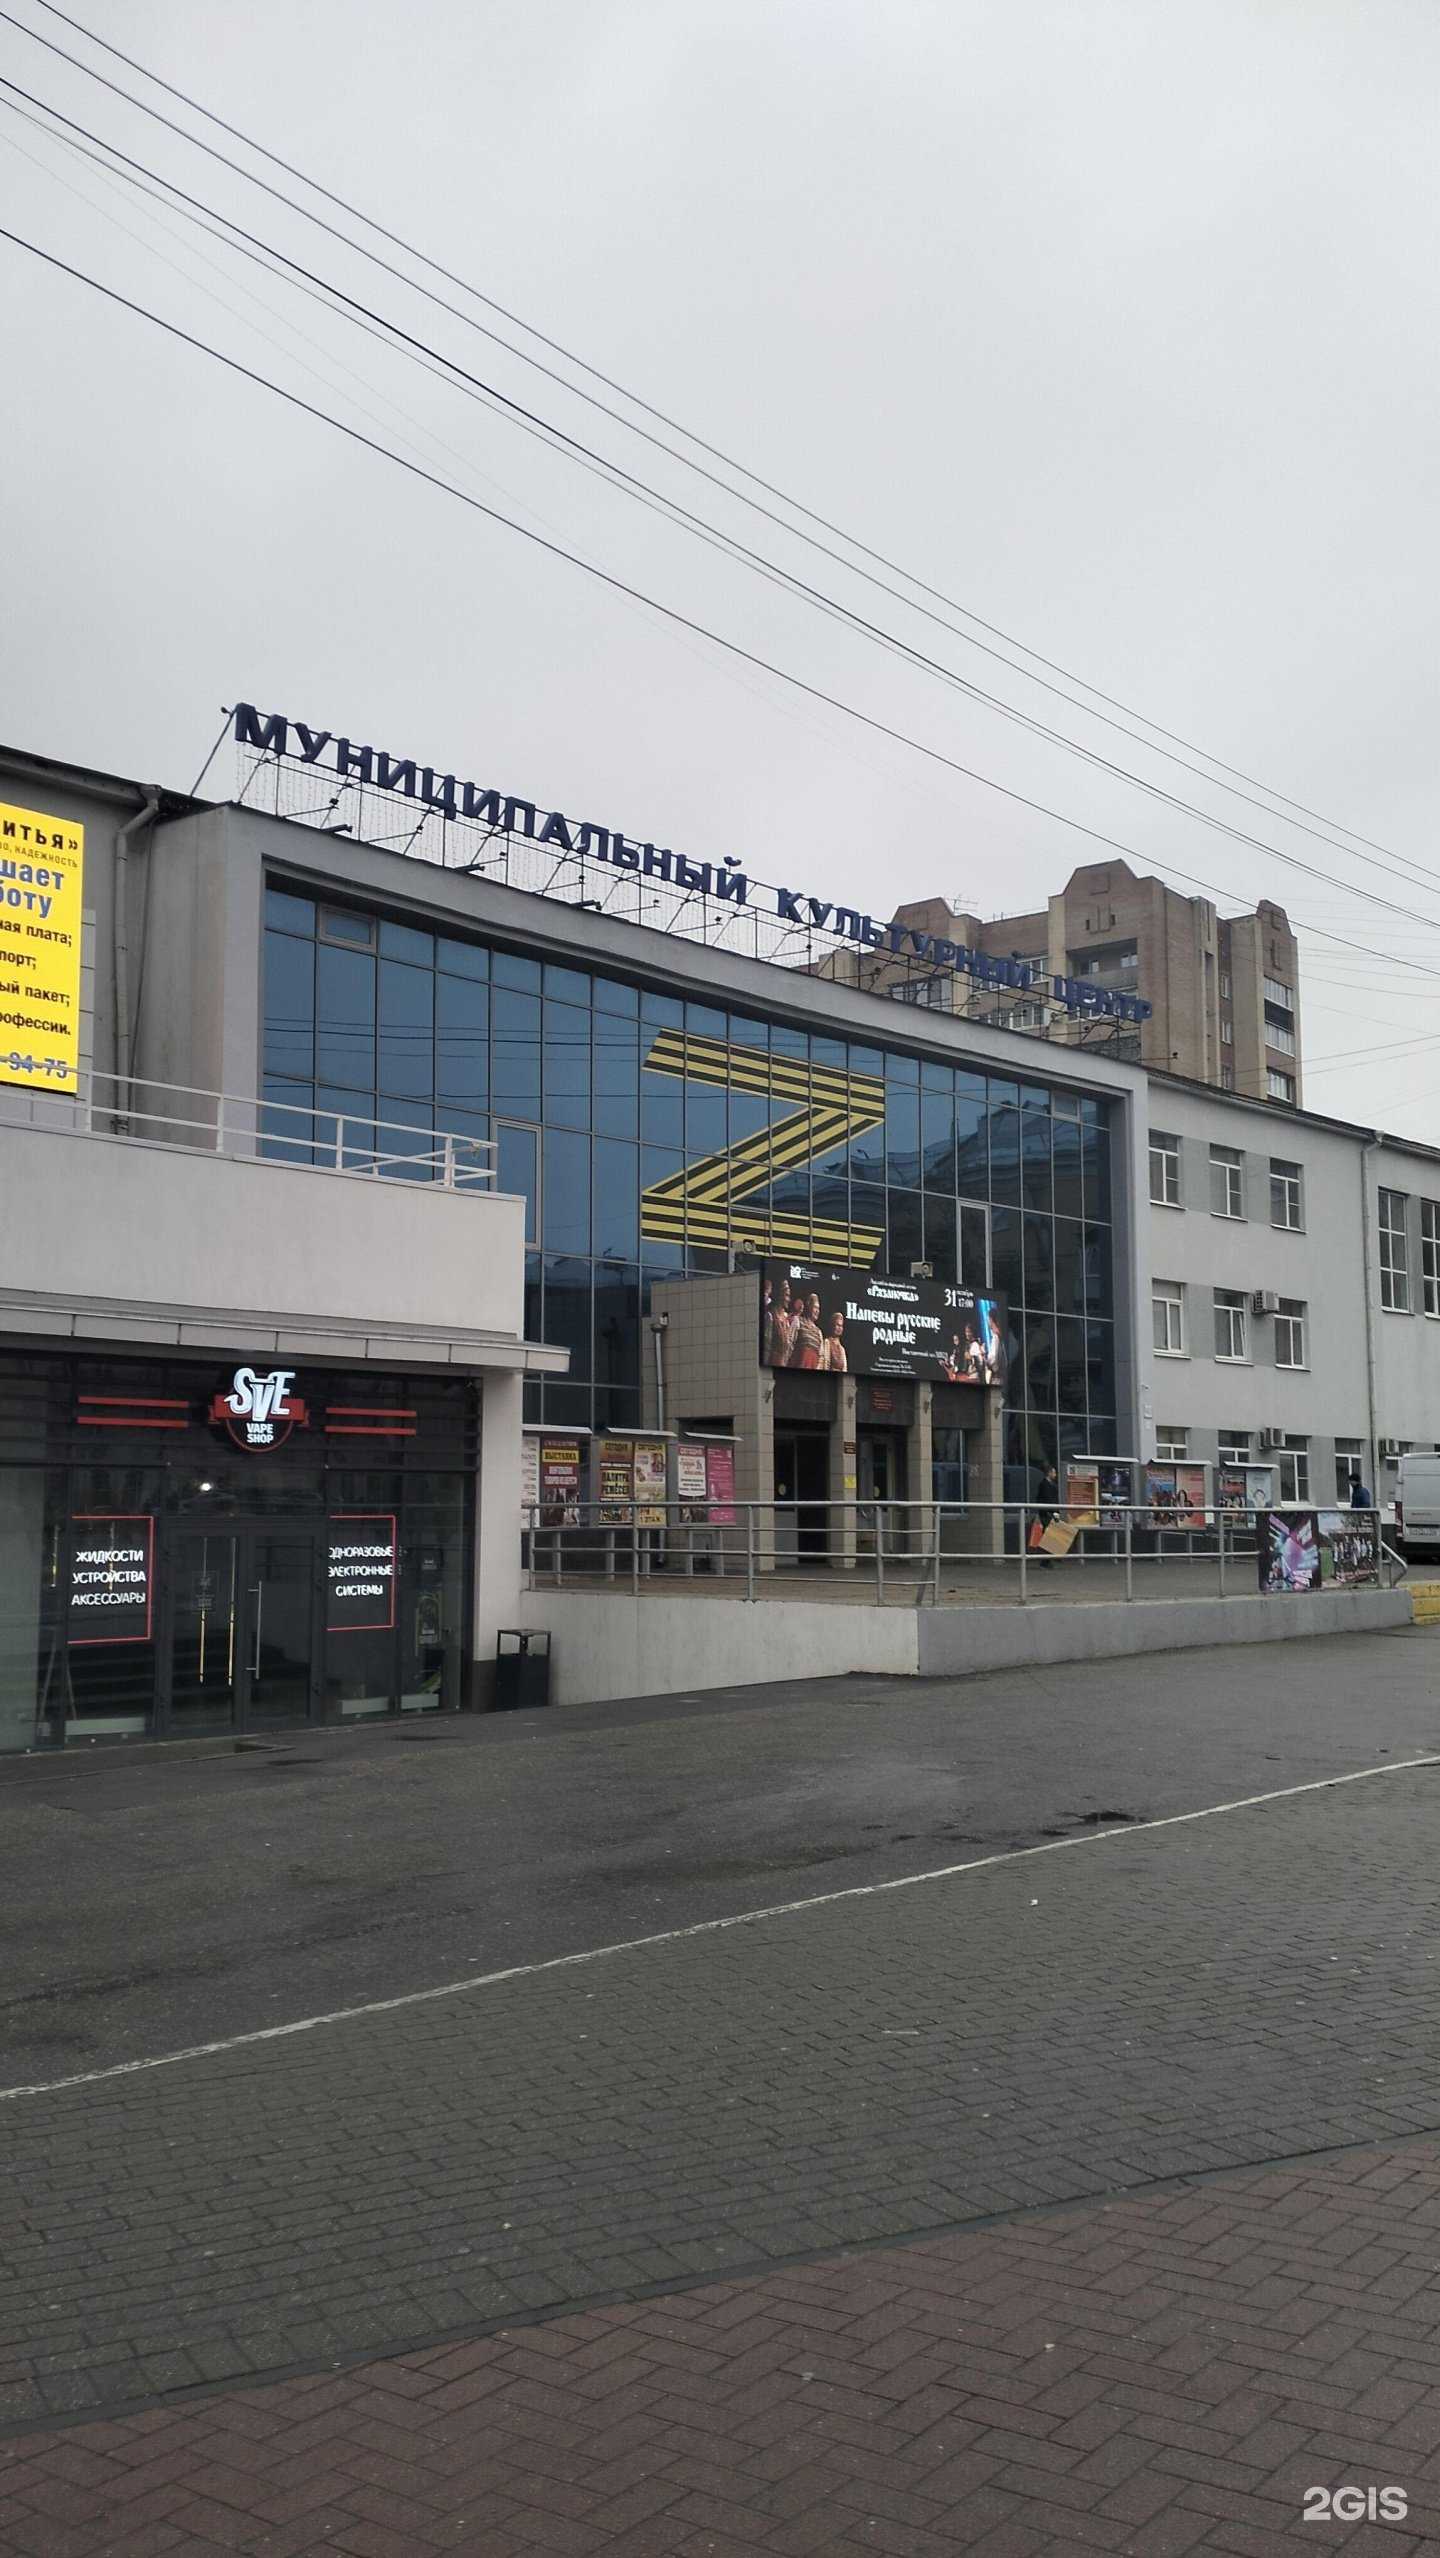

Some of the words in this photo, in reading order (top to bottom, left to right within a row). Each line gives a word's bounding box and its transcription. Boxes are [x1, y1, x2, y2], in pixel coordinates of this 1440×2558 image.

[235, 703, 747, 904] МУНИЦИПАЛЬНЫЙ
[778, 888, 1030, 991] КУЛЬТУРНЫЙ
[15, 846, 78, 868] НАДЕЖНОСТЬ
[26, 925, 72, 948] плата;
[25, 986, 70, 1007] пакет;
[944, 1288, 957, 1307] 31
[846, 1301, 895, 1325] Напевы
[872, 1326, 916, 1345] родные
[223, 1367, 296, 1422] SVE
[246, 1422, 274, 1434] VAPE
[246, 1433, 274, 1444] SHOP
[76, 1550, 144, 1564] ЖИДКОСТИ
[72, 1570, 147, 1584] УСТРОЙСТВА
[327, 1564, 394, 1578] ЭЛЕКТРОННЫЕ
[71, 1591, 146, 1606] АКСЕССУАРЫ
[335, 1584, 383, 1597] СИСТЕМЫ
